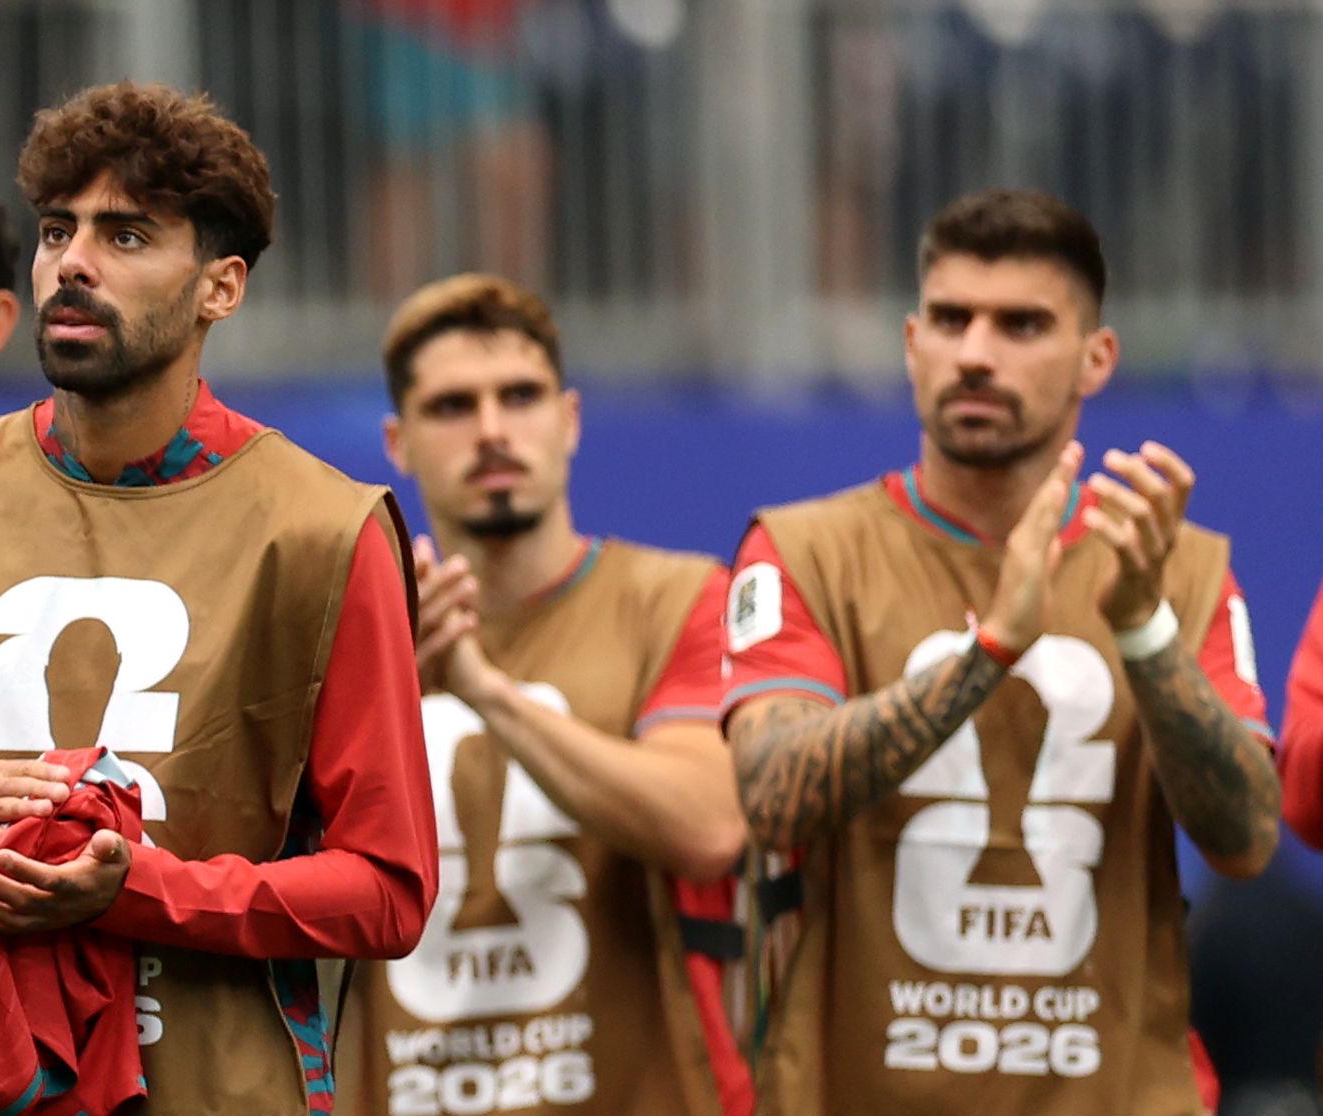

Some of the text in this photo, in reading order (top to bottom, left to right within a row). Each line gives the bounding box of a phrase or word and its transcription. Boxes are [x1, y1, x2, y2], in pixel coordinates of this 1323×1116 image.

[958, 906, 1052, 939] FIFA
[446, 946, 536, 984] FIFA
[888, 980, 1101, 1022] WORLD CUP
[385, 1013, 594, 1065] WORLD CUP
[884, 1017, 1102, 1078] 2026
